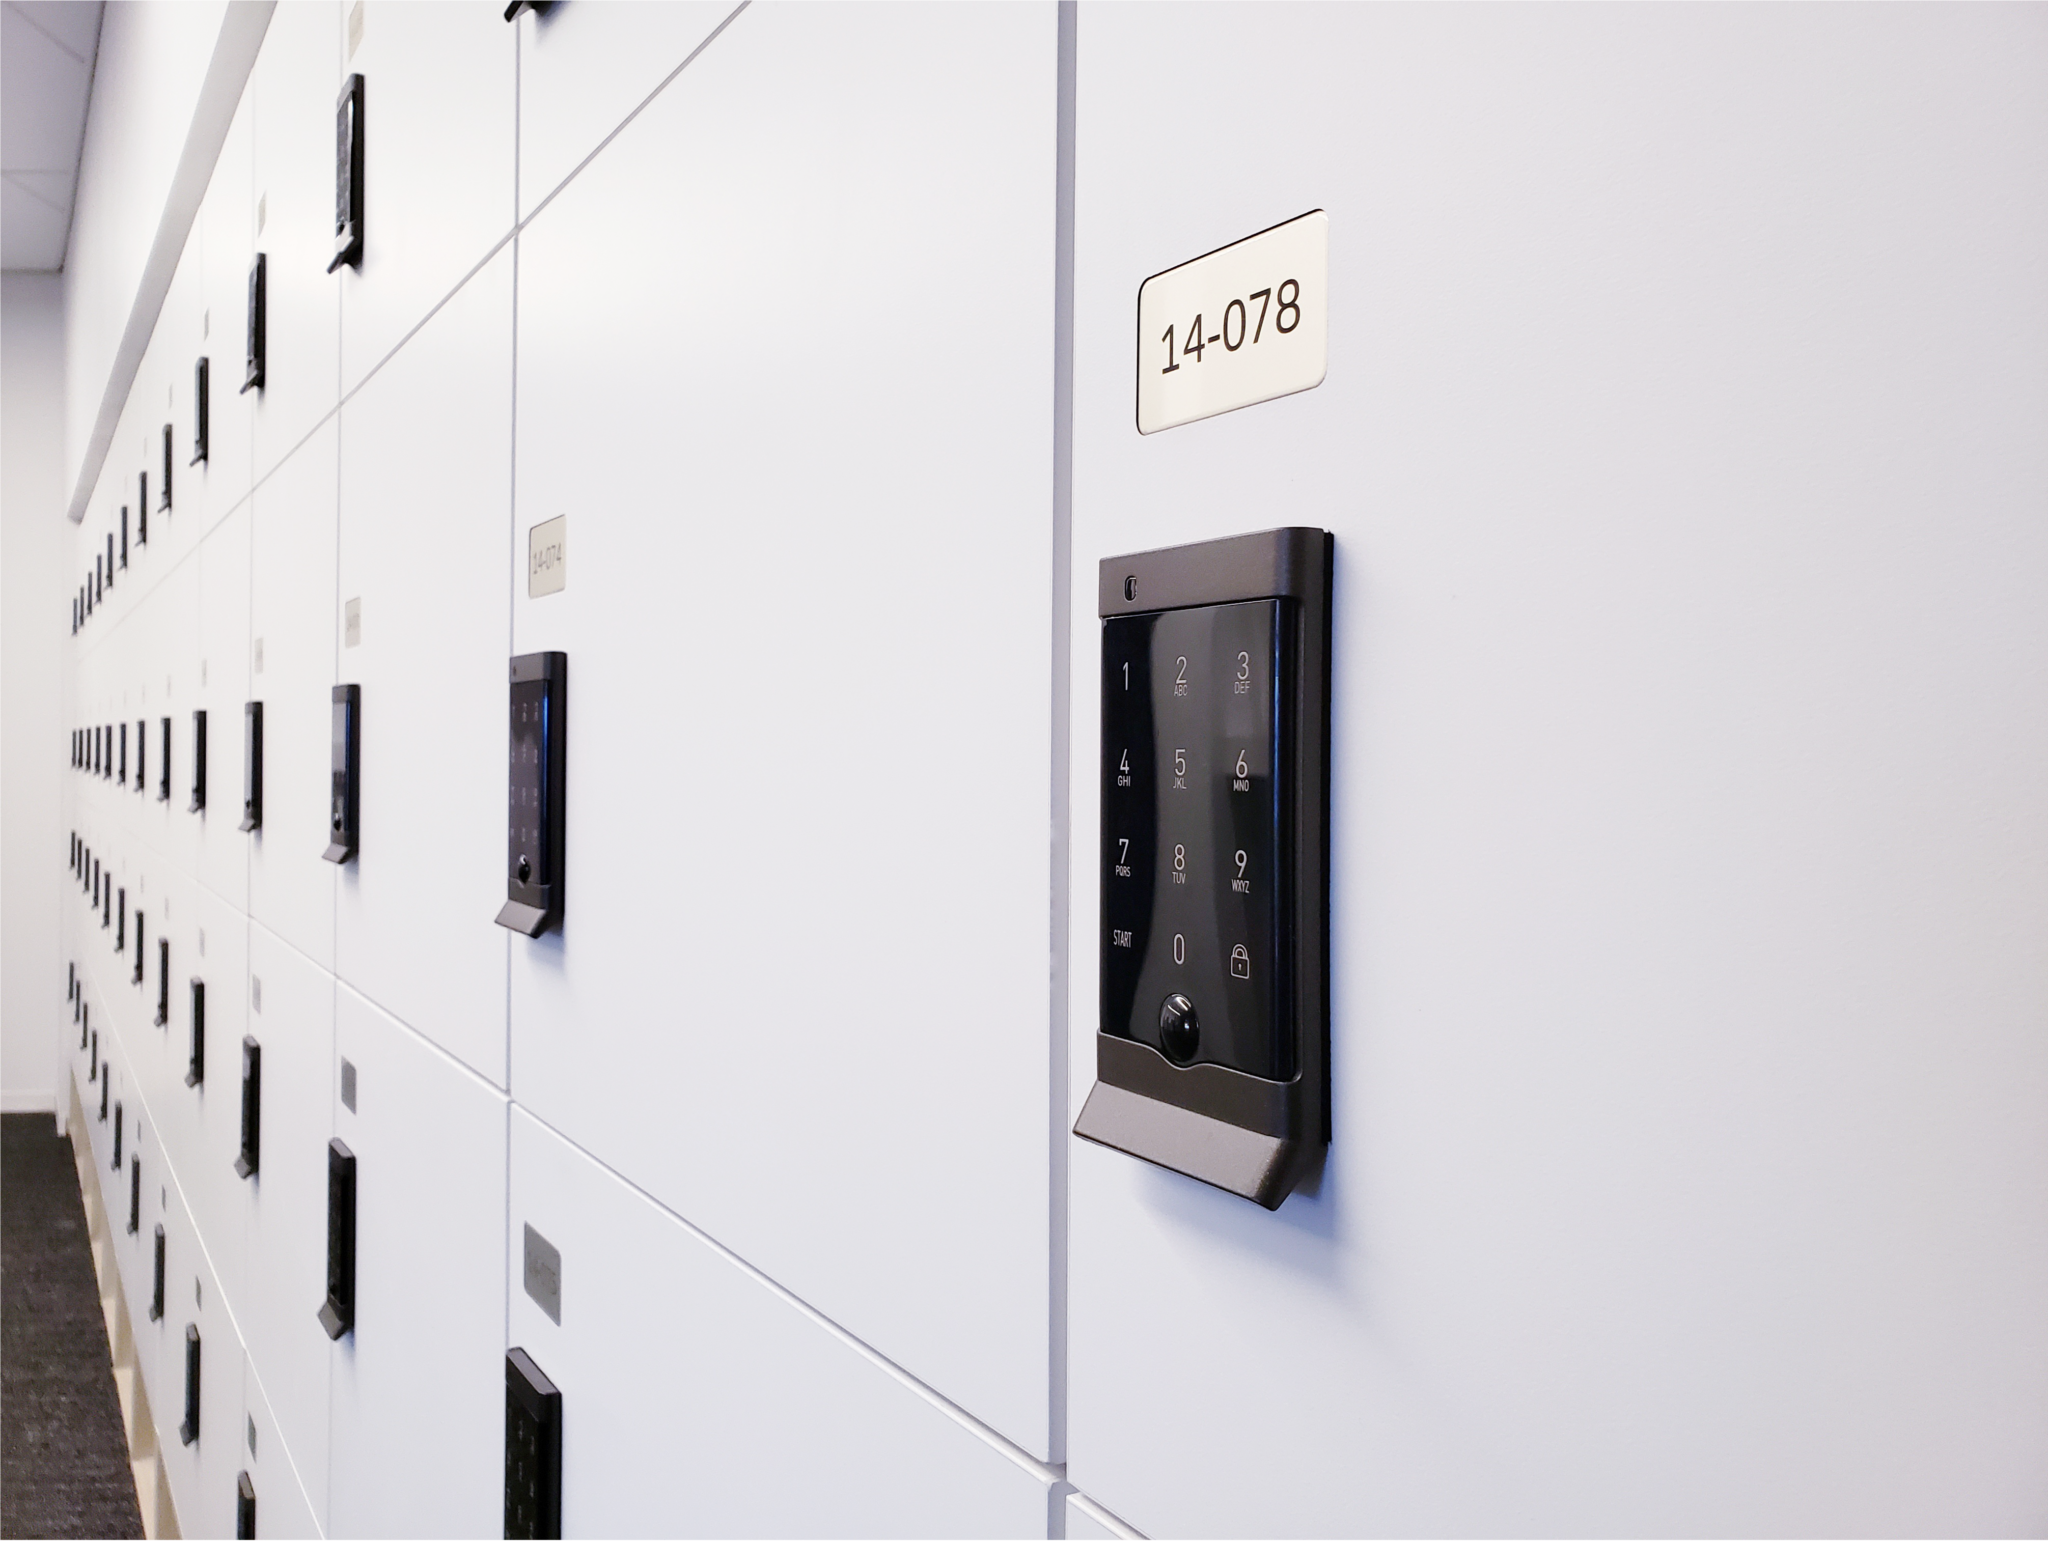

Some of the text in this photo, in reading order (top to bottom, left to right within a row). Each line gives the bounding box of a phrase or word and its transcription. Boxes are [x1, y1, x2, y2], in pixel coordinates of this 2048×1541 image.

[1161, 278, 1301, 375] 14-078
[1122, 661, 1129, 691] 1
[1175, 656, 1187, 684] 2
[1236, 651, 1249, 680] 3
[1173, 684, 1188, 697] ABC
[1234, 681, 1250, 694] DEF
[1119, 748, 1130, 774] 4
[1174, 749, 1186, 776] 5
[1235, 749, 1248, 778] 6
[1117, 775, 1131, 787] GHI
[1172, 777, 1187, 789] JKL
[1233, 778, 1250, 792] MNO
[1118, 838, 1130, 864] 7
[1174, 843, 1185, 871] 8
[1234, 849, 1247, 878] 9
[1115, 865, 1131, 877] PQRS
[1172, 871, 1186, 884] TUV
[1231, 878, 1250, 893] WXYZ
[1113, 929, 1132, 948] START
[1173, 933, 1185, 965] 0
